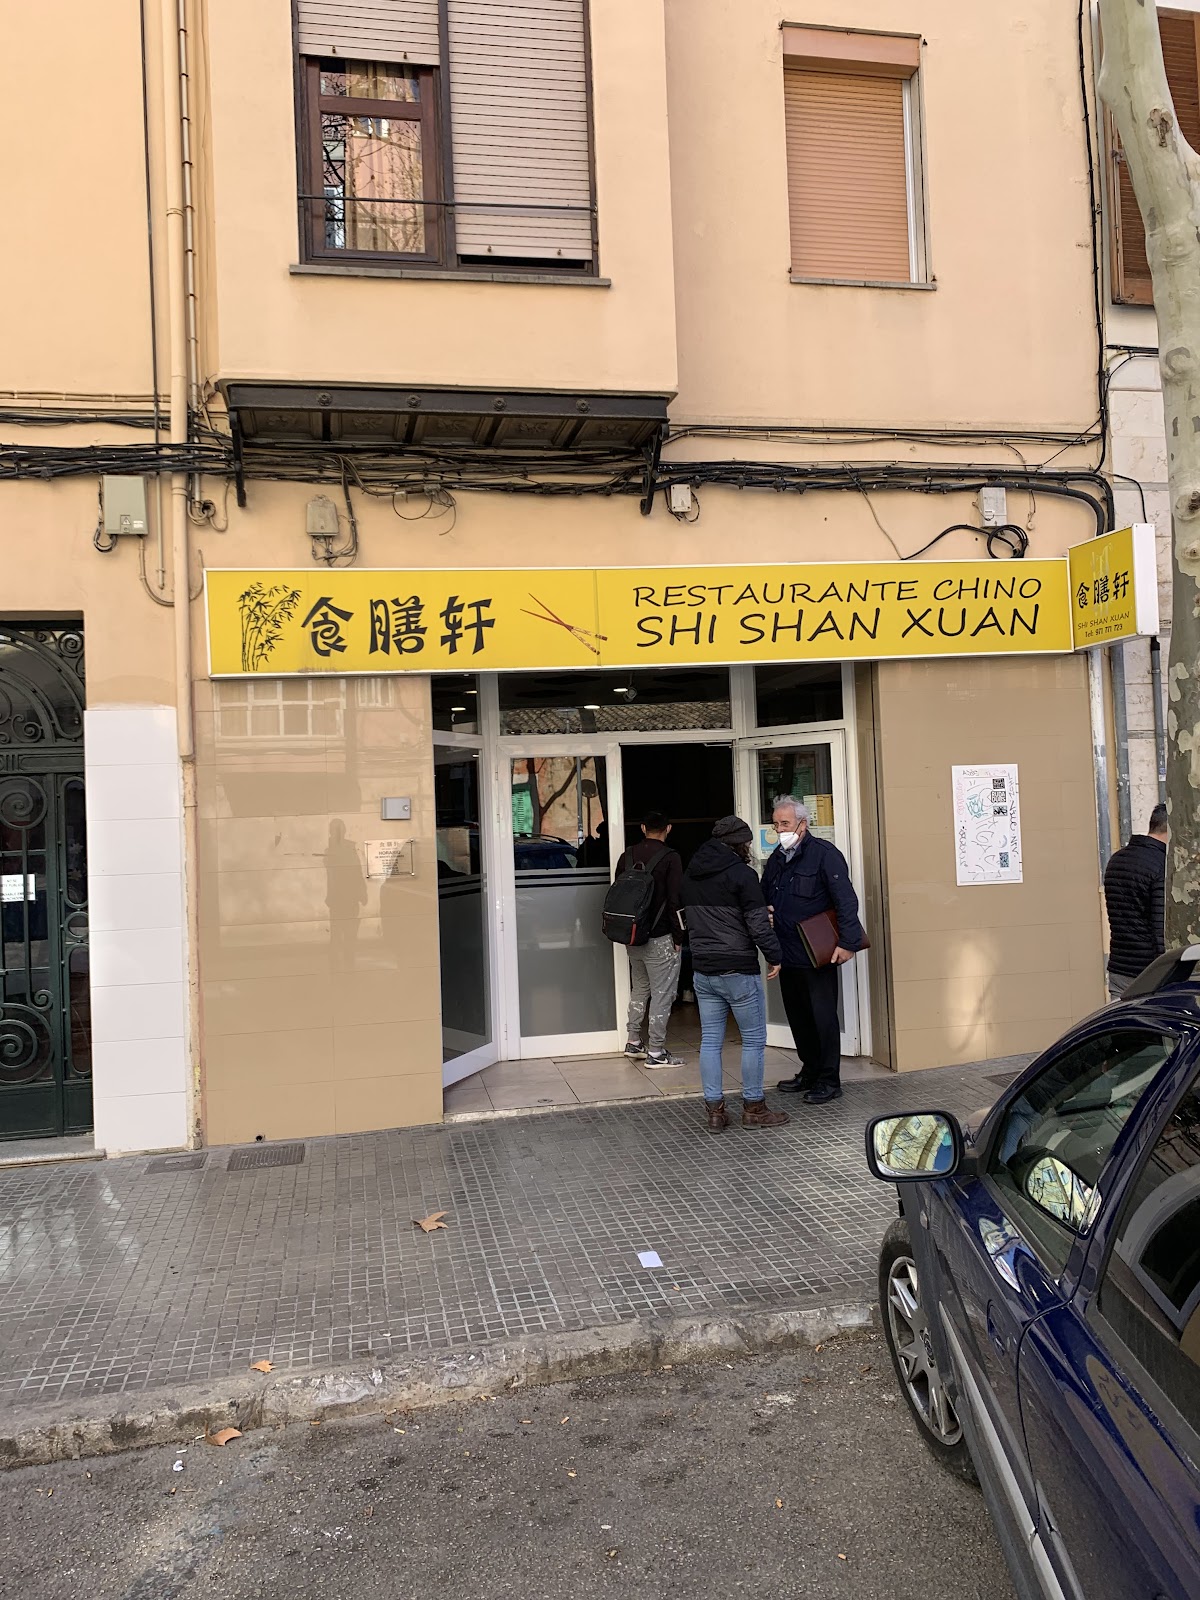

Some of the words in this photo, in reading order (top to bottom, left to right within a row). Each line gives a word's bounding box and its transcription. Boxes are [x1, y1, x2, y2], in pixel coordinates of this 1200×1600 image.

[632, 579, 919, 607] RESTAURANTE
[933, 576, 1042, 601] CHINO
[1076, 570, 1130, 609] 食膳轩
[301, 595, 495, 657] 食膳轩
[637, 611, 717, 648] SHI
[739, 607, 881, 645] SHAN
[902, 603, 1040, 639] XUAN
[1078, 622, 1088, 630] SHI
[1089, 617, 1108, 628] SHAN
[1109, 611, 1130, 622] XUAN
